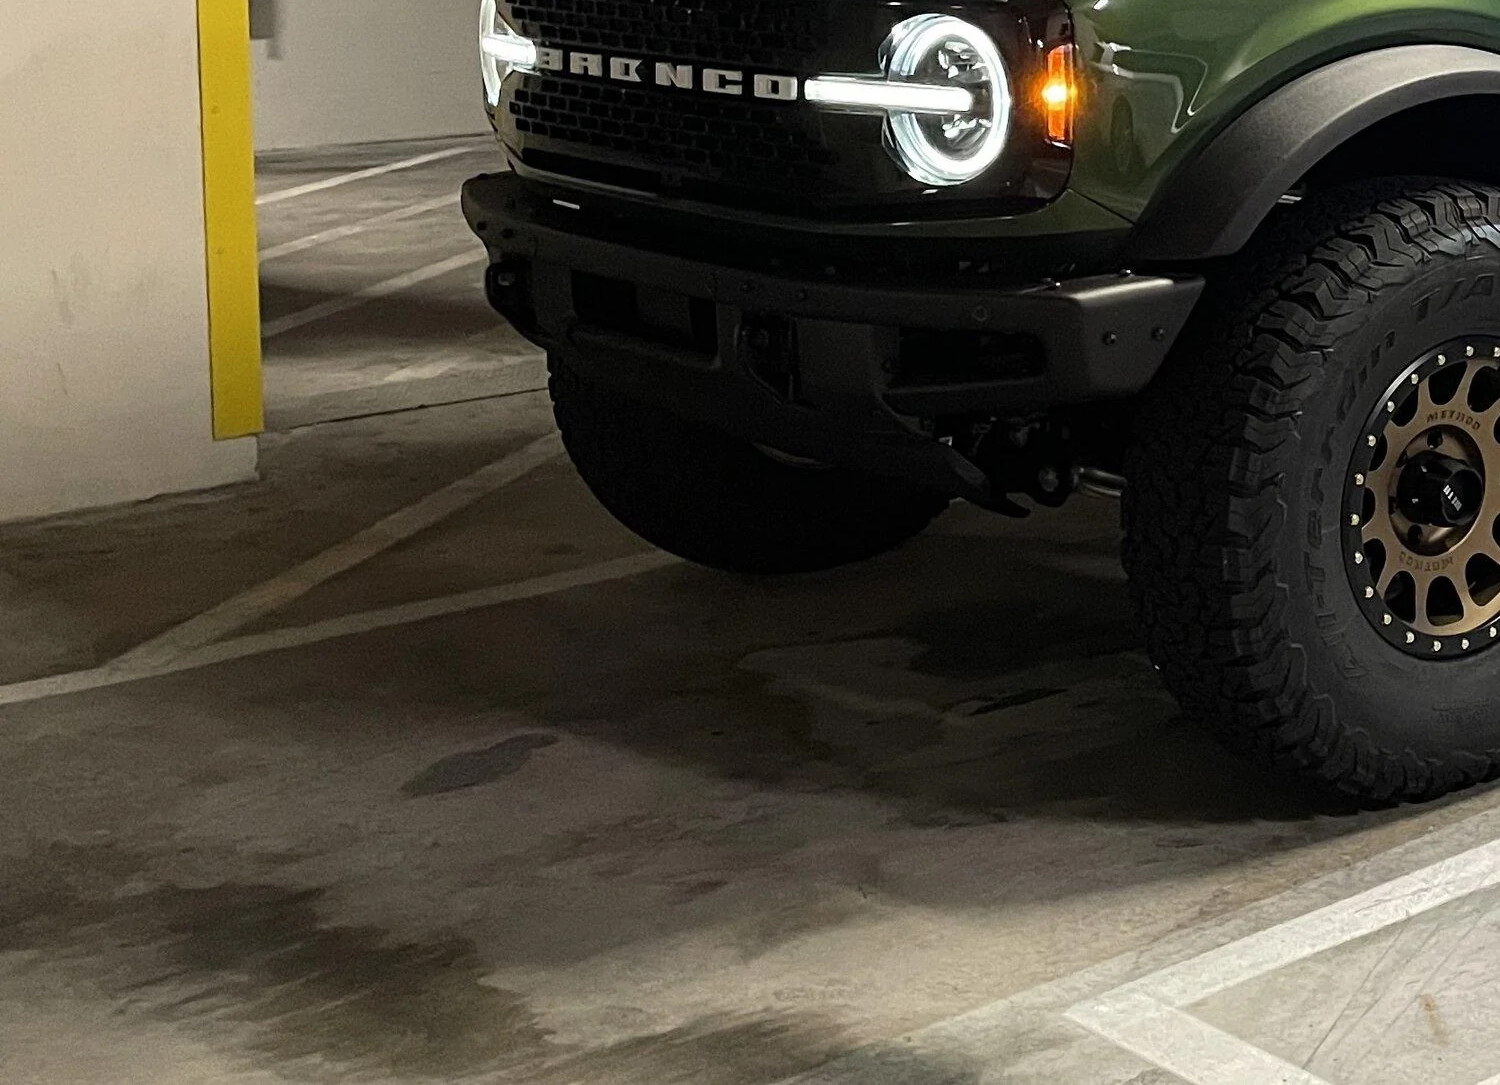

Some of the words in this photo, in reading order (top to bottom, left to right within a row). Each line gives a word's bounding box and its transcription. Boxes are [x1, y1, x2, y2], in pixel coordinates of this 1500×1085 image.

[536, 46, 798, 101] BRONCO
[1427, 410, 1480, 430] METHOD
[1399, 551, 1454, 572] METHOD
